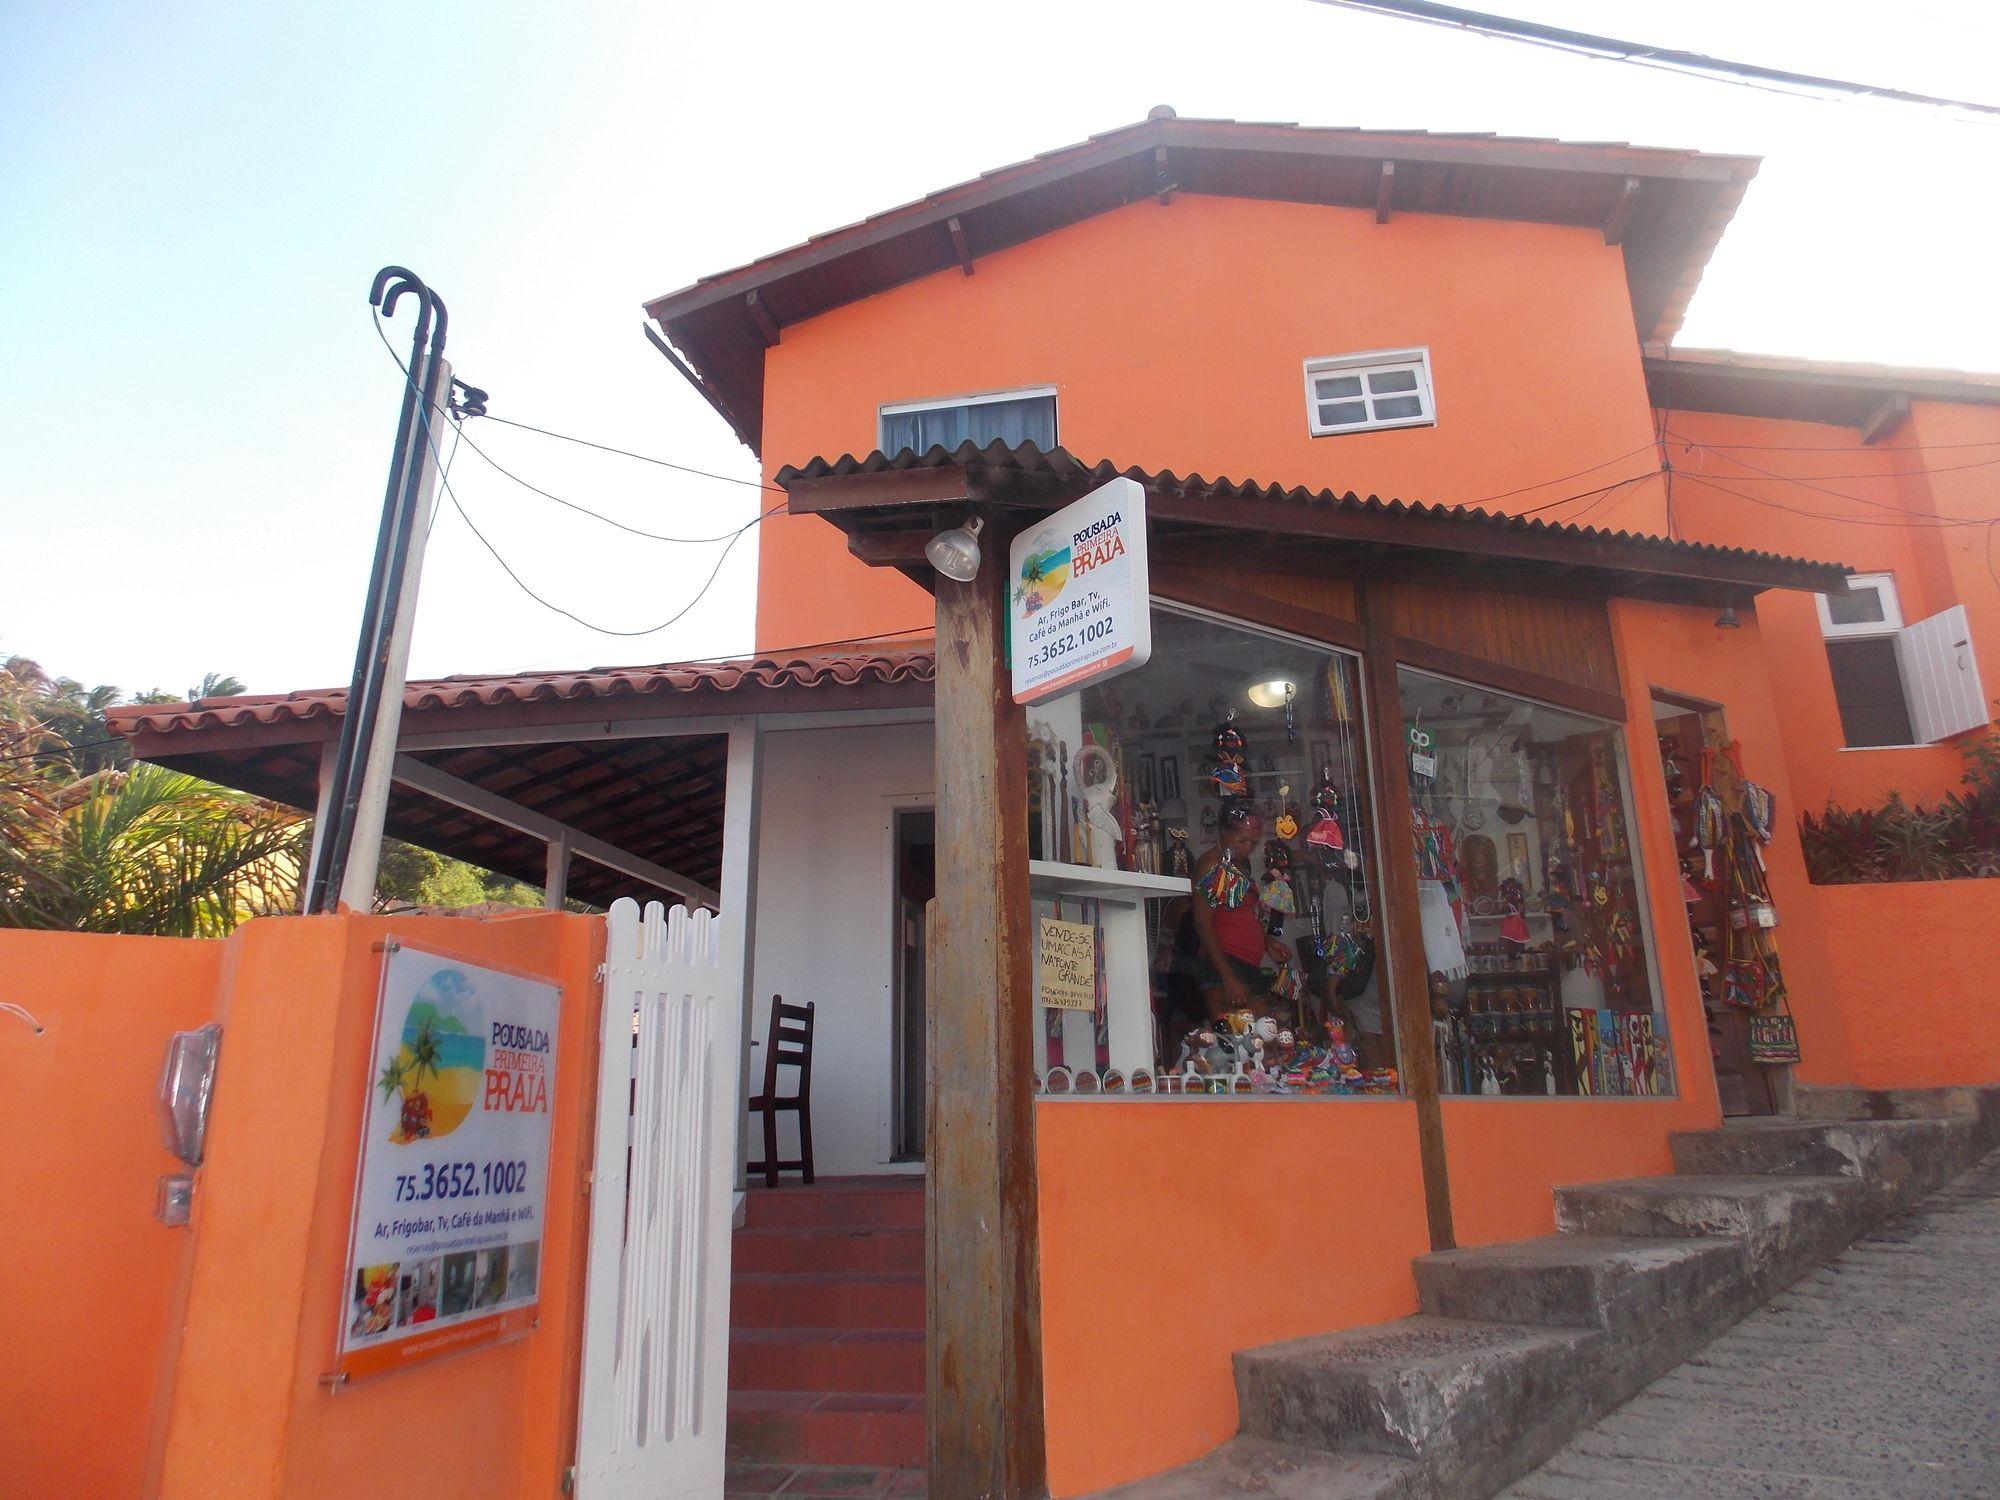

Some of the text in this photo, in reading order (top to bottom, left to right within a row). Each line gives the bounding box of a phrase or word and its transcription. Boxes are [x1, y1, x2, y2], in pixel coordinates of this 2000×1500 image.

[1072, 511, 1122, 546] POUSADA
[1076, 526, 1119, 555] PRIMEIRA
[1072, 535, 1125, 578] PRAIA
[1029, 598, 1111, 643] Café da Manhã e Wifi.
[1037, 591, 1101, 627] Ar, Frigo Bar, Tv,
[1028, 616, 1114, 668] 75.3652.1002
[492, 1022, 550, 1053] POUSADA
[494, 1049, 545, 1074] PRIMEIRA
[484, 1069, 548, 1113] PRAIA
[396, 1160, 527, 1202] 75.3652.1002
[374, 1222, 389, 1240] Ar,
[392, 1216, 435, 1238] Frigobar,
[437, 1215, 450, 1232] Tv,
[451, 1211, 471, 1230] Café
[473, 1209, 483, 1225] da
[484, 1208, 510, 1225] Manhã
[510, 1211, 516, 1221] e
